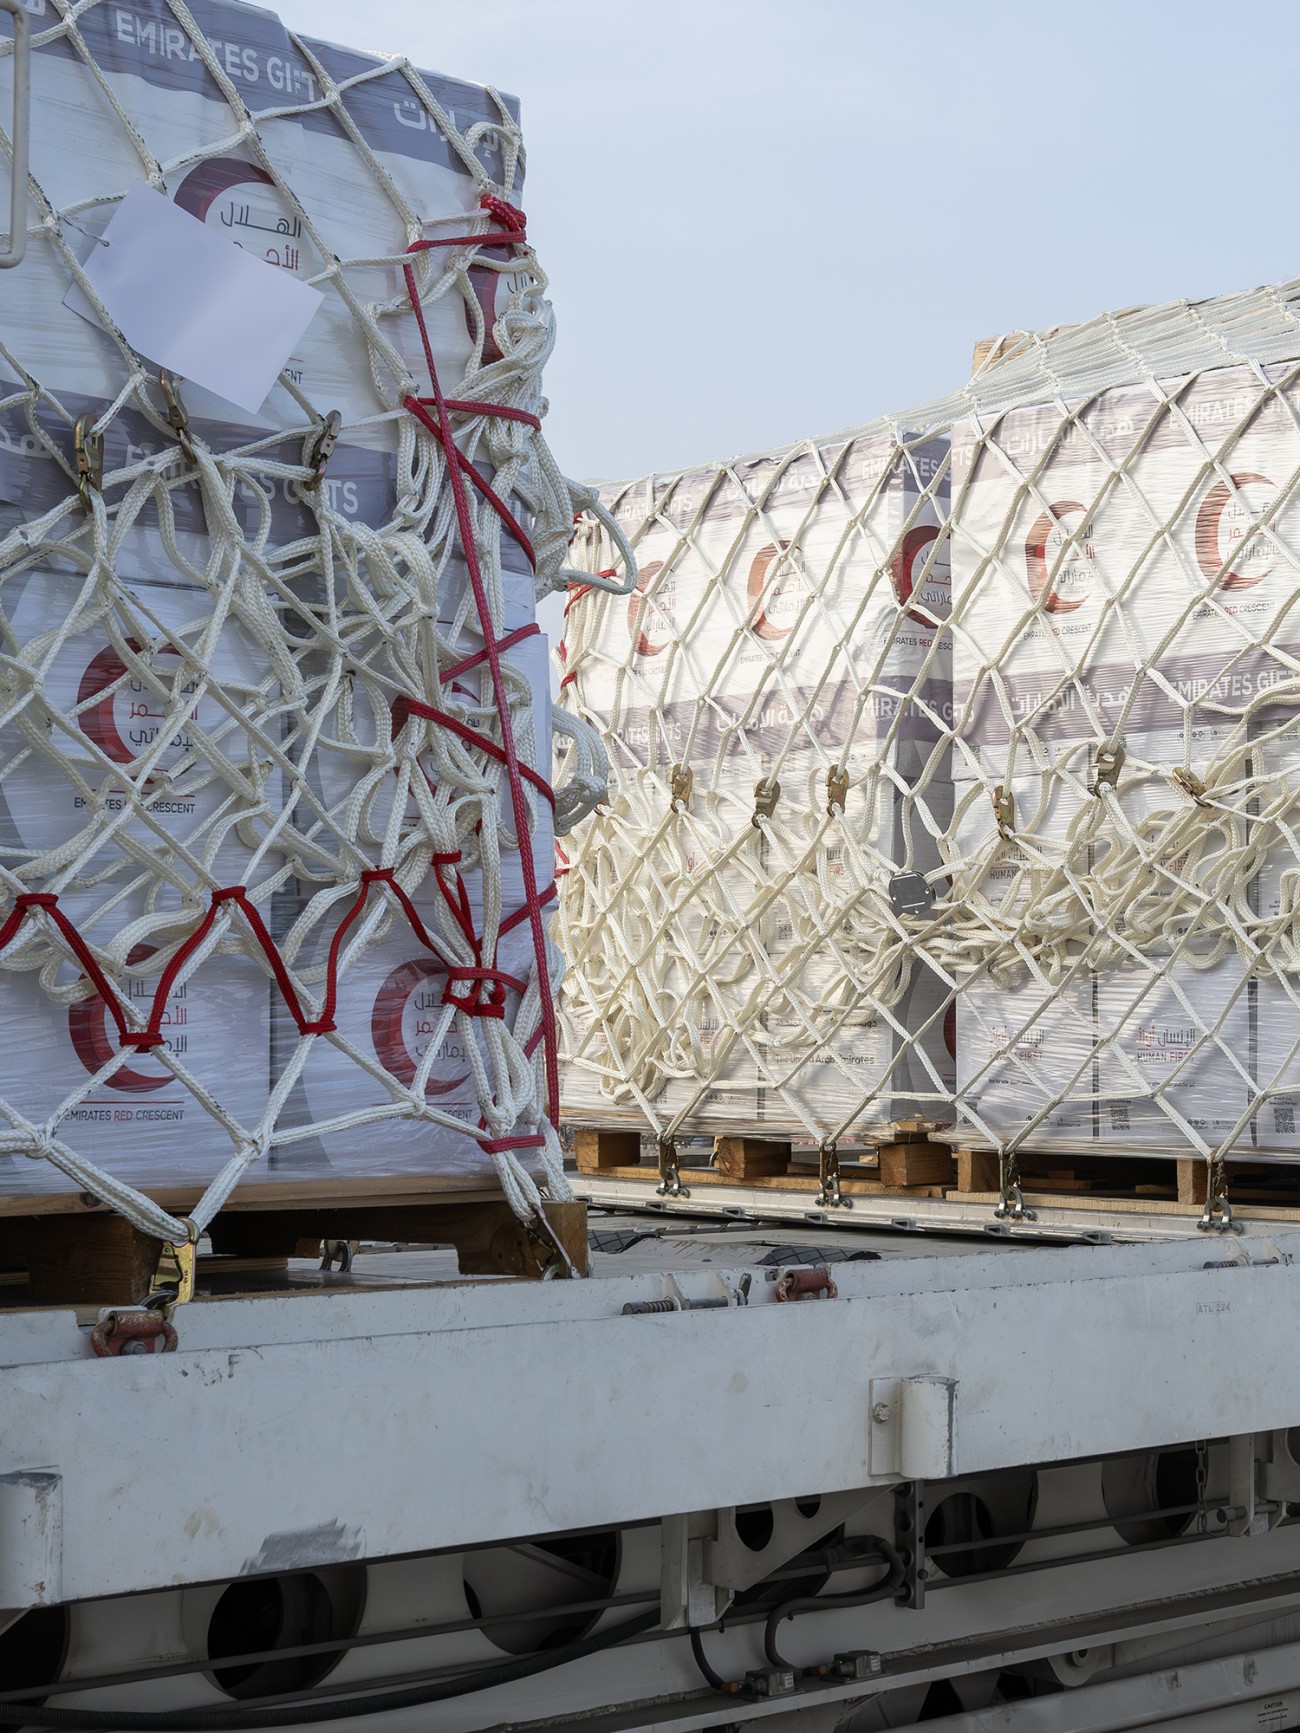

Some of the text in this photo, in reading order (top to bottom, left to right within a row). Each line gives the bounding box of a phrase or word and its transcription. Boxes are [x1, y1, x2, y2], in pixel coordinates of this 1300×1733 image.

[267, 56, 318, 102] GIFT
[919, 637, 932, 647] RED
[827, 864, 845, 876] FIRS
[1137, 1051, 1194, 1062] HUMAN FIR
[63, 1110, 184, 1121] EMIRATES RED CRESCENT
